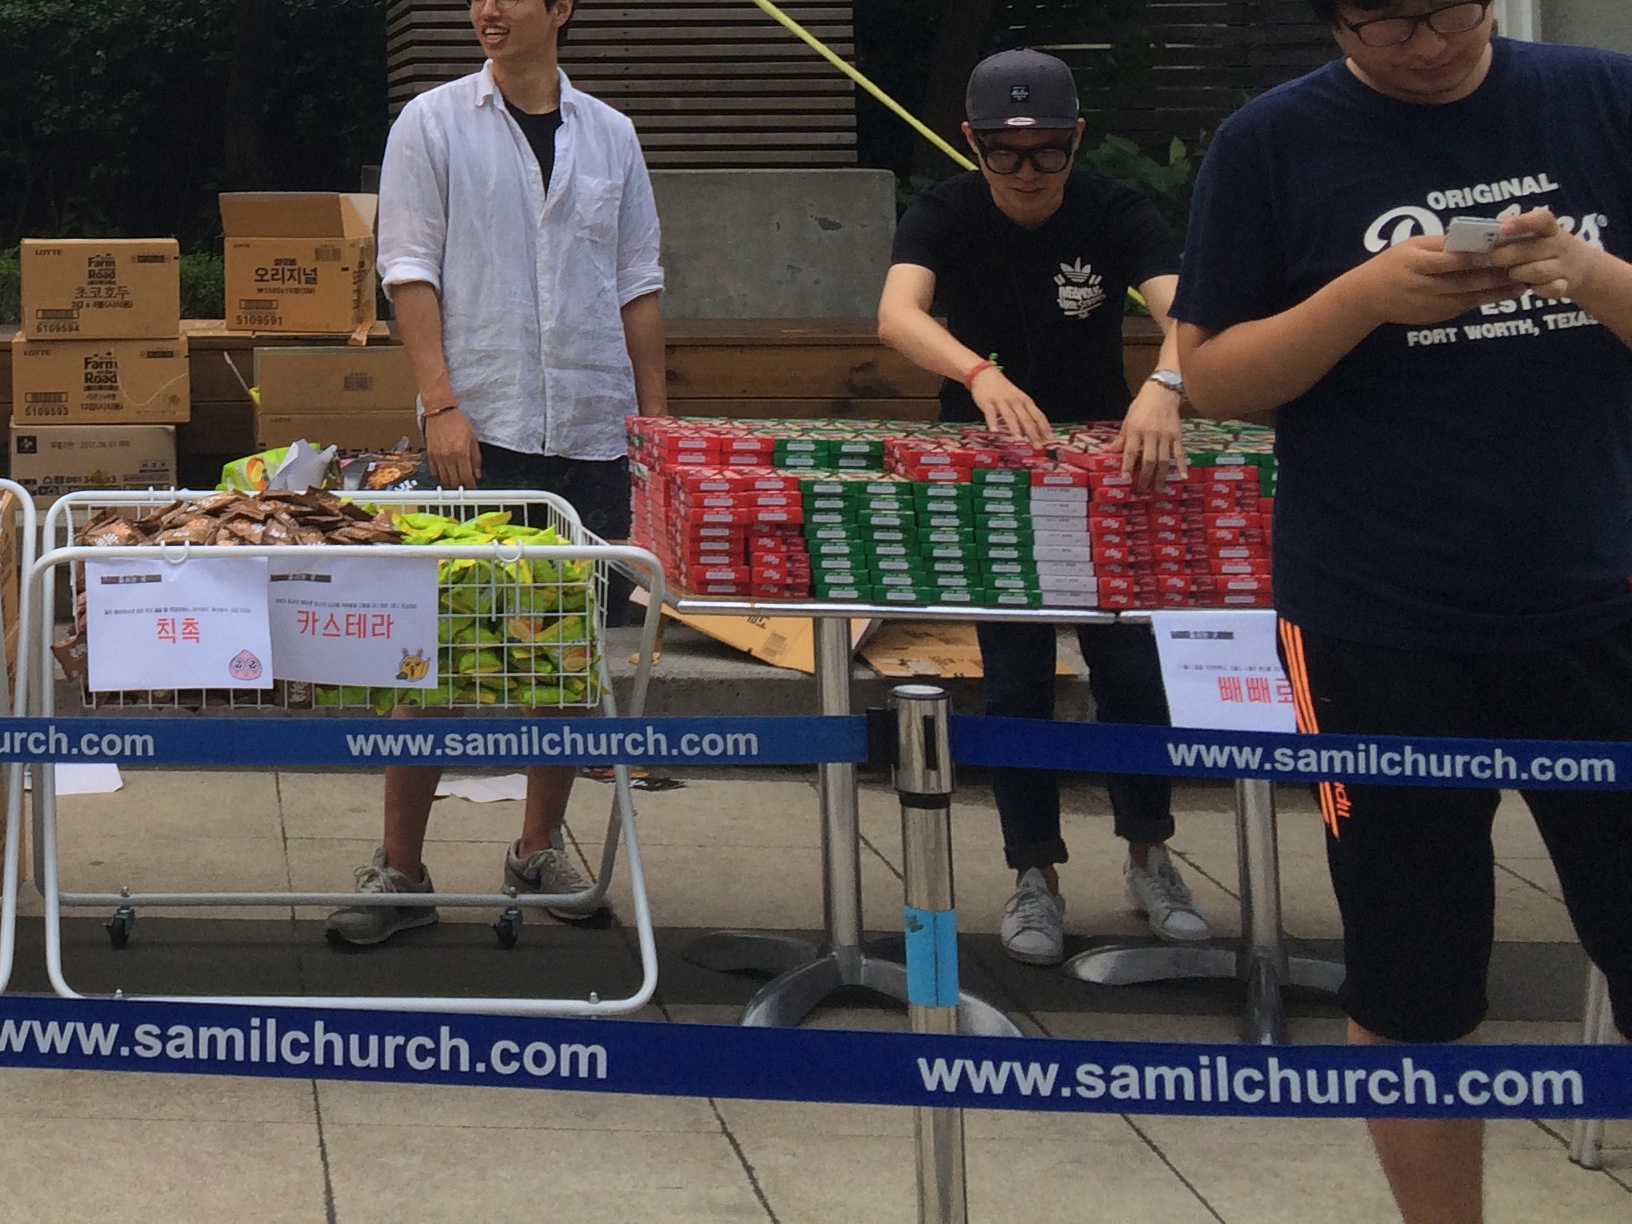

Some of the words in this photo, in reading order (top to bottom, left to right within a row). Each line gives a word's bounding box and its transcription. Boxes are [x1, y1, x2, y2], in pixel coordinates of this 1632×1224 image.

[1426, 173, 1559, 211] ORIGINAL
[88, 257, 116, 268] Farm
[88, 269, 116, 280] Road
[254, 267, 318, 285] 오리지널
[74, 286, 130, 300] 초코호두
[236, 315, 283, 326] 5109591
[1407, 327, 1458, 348] FORT
[1464, 318, 1540, 345] WORTH,
[84, 372, 118, 384] Road
[156, 617, 200, 644] 칙촉
[296, 610, 394, 639] 카스테라
[346, 726, 758, 757] www.samilchurch.com
[1167, 743, 1616, 782] www.samilchurch.com
[918, 1056, 1584, 1106] www.samilchurch.com
